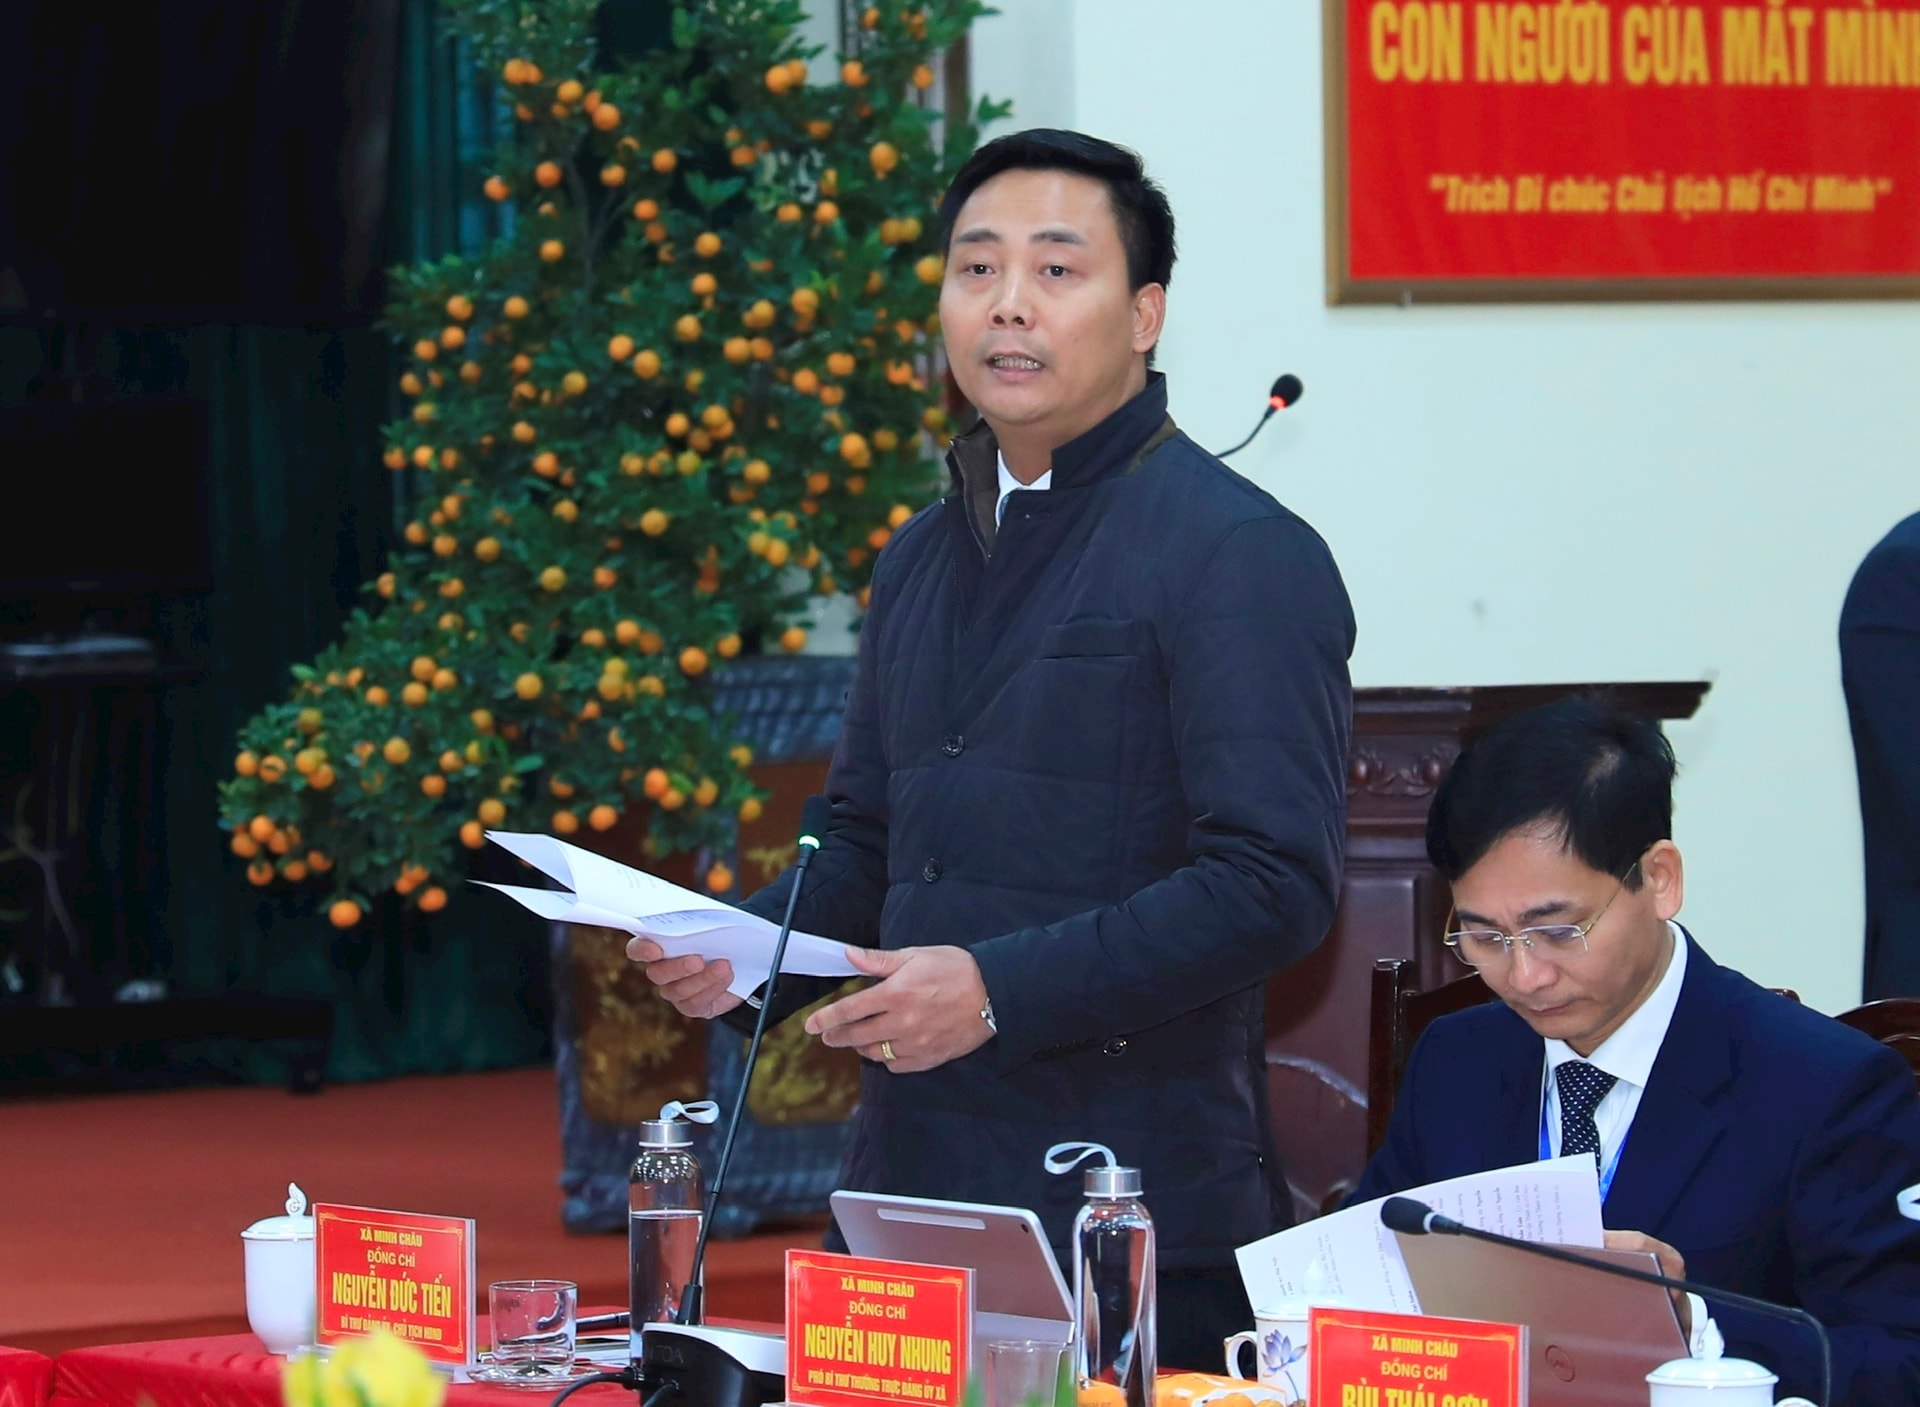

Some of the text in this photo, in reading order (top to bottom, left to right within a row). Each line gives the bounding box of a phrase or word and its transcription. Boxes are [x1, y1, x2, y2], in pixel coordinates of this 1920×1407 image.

[1370, 2, 1462, 82] CON
[1622, 0, 1710, 84] CỦA
[1825, 0, 1920, 86] MÌN
[374, 1229, 397, 1244] MINH
[332, 1265, 452, 1318] NGUYỄN ĐỨC TIẾN
[857, 1278, 885, 1295] MINH
[887, 1280, 915, 1298] CHÂU
[886, 1304, 906, 1320] CHÍ
[804, 1315, 952, 1375] NGUYỄN HUY NHUNG
[1391, 1336, 1423, 1355] MINH
[1425, 1338, 1459, 1358] CHÂU
[807, 1368, 824, 1385] PHÓ
[835, 1371, 850, 1388] THƯ
[1424, 1363, 1448, 1381] CHÍ
